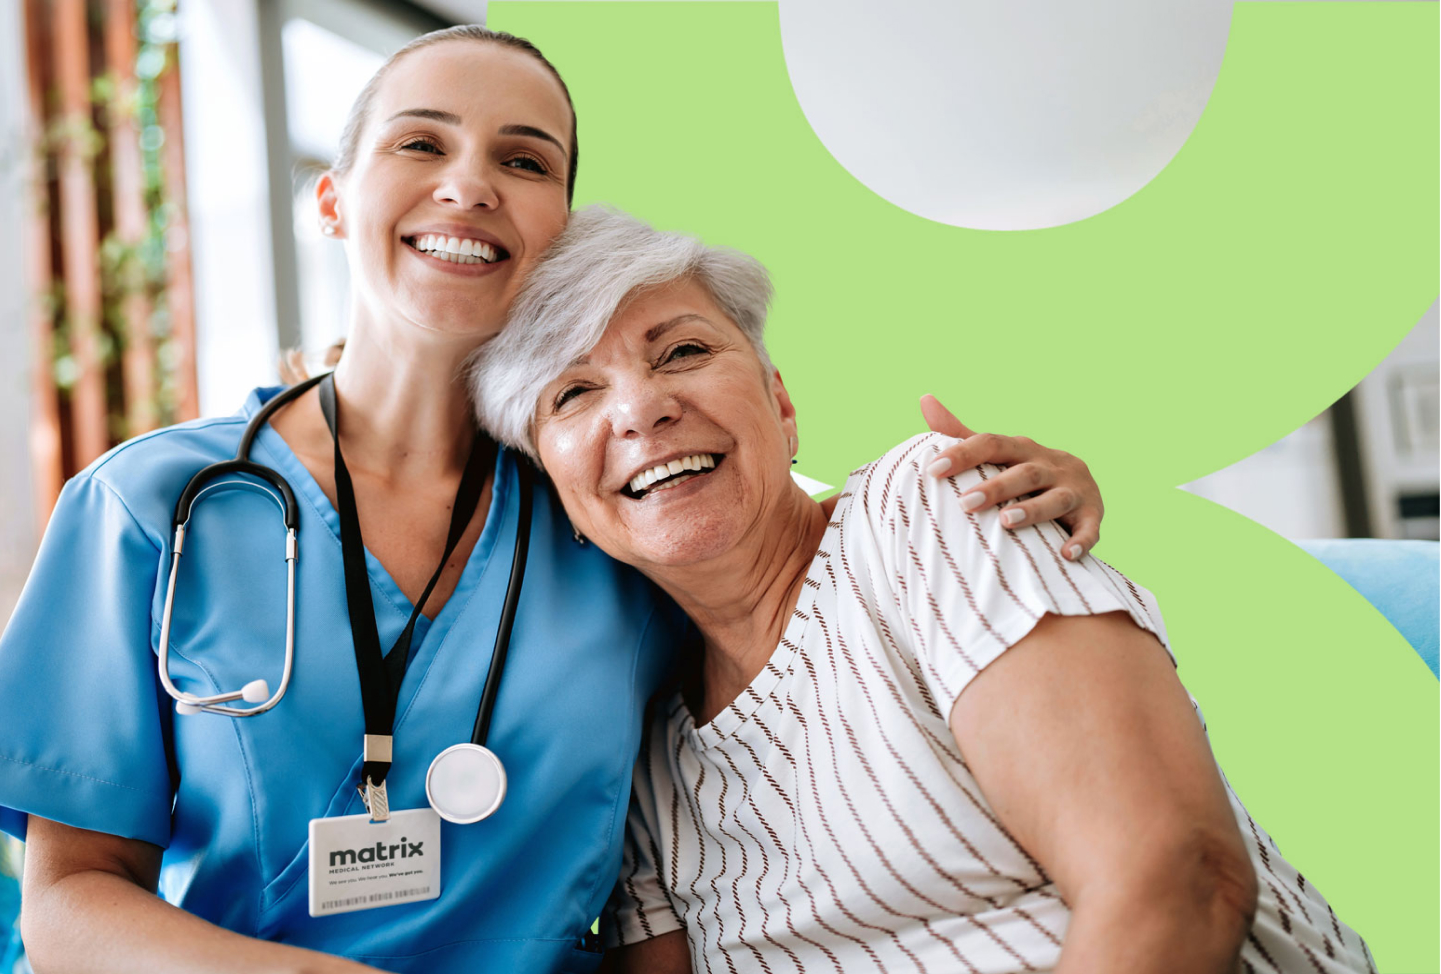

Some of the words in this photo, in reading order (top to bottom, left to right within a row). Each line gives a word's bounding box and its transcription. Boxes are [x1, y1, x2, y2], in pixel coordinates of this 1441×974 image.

[329, 836, 424, 866] matrix
[329, 866, 359, 875] MEDICAL
[361, 862, 395, 870] NETWORK
